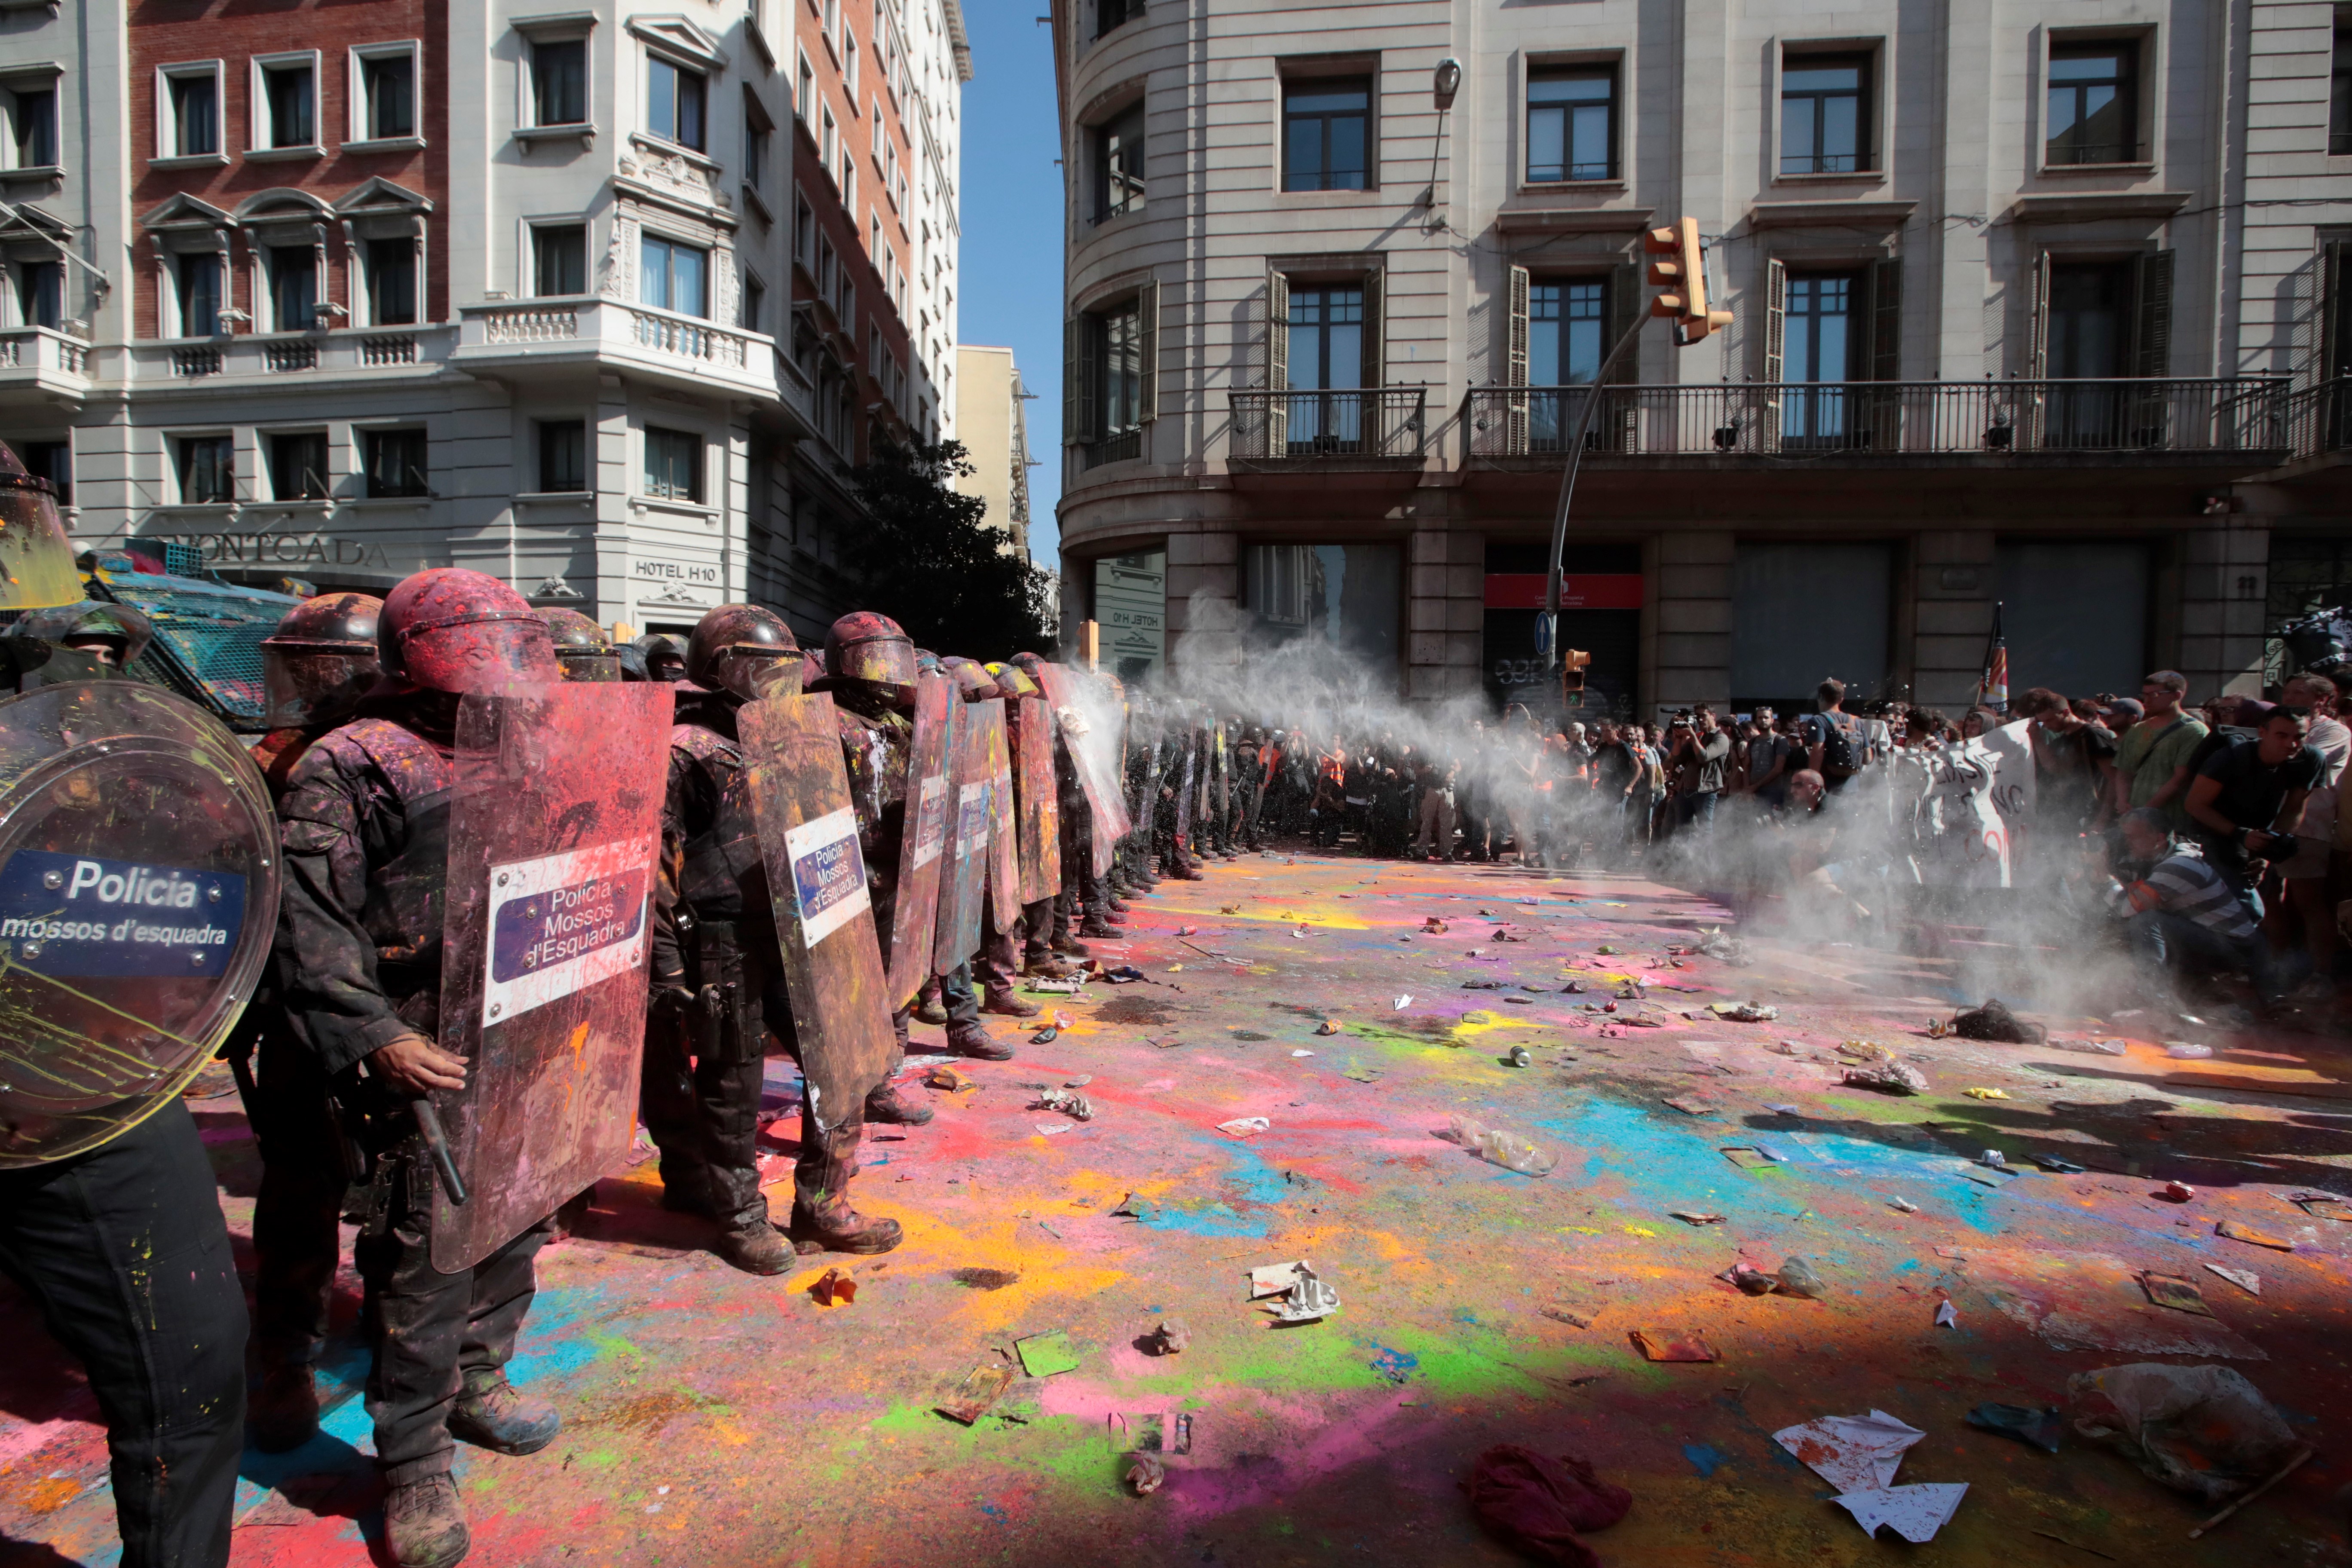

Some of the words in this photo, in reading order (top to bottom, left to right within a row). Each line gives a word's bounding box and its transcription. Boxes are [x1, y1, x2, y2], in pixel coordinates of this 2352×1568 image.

[636, 561, 685, 579] HOTEL
[689, 567, 716, 581] H10
[815, 842, 844, 868] Policia
[67, 861, 197, 908] Policia
[817, 860, 848, 887] Mossos
[551, 881, 611, 912] Polica
[1, 917, 105, 940] mossos
[112, 919, 227, 947] d'esquadra
[545, 903, 613, 937] Mossos
[525, 921, 624, 968] d'Esquadra
